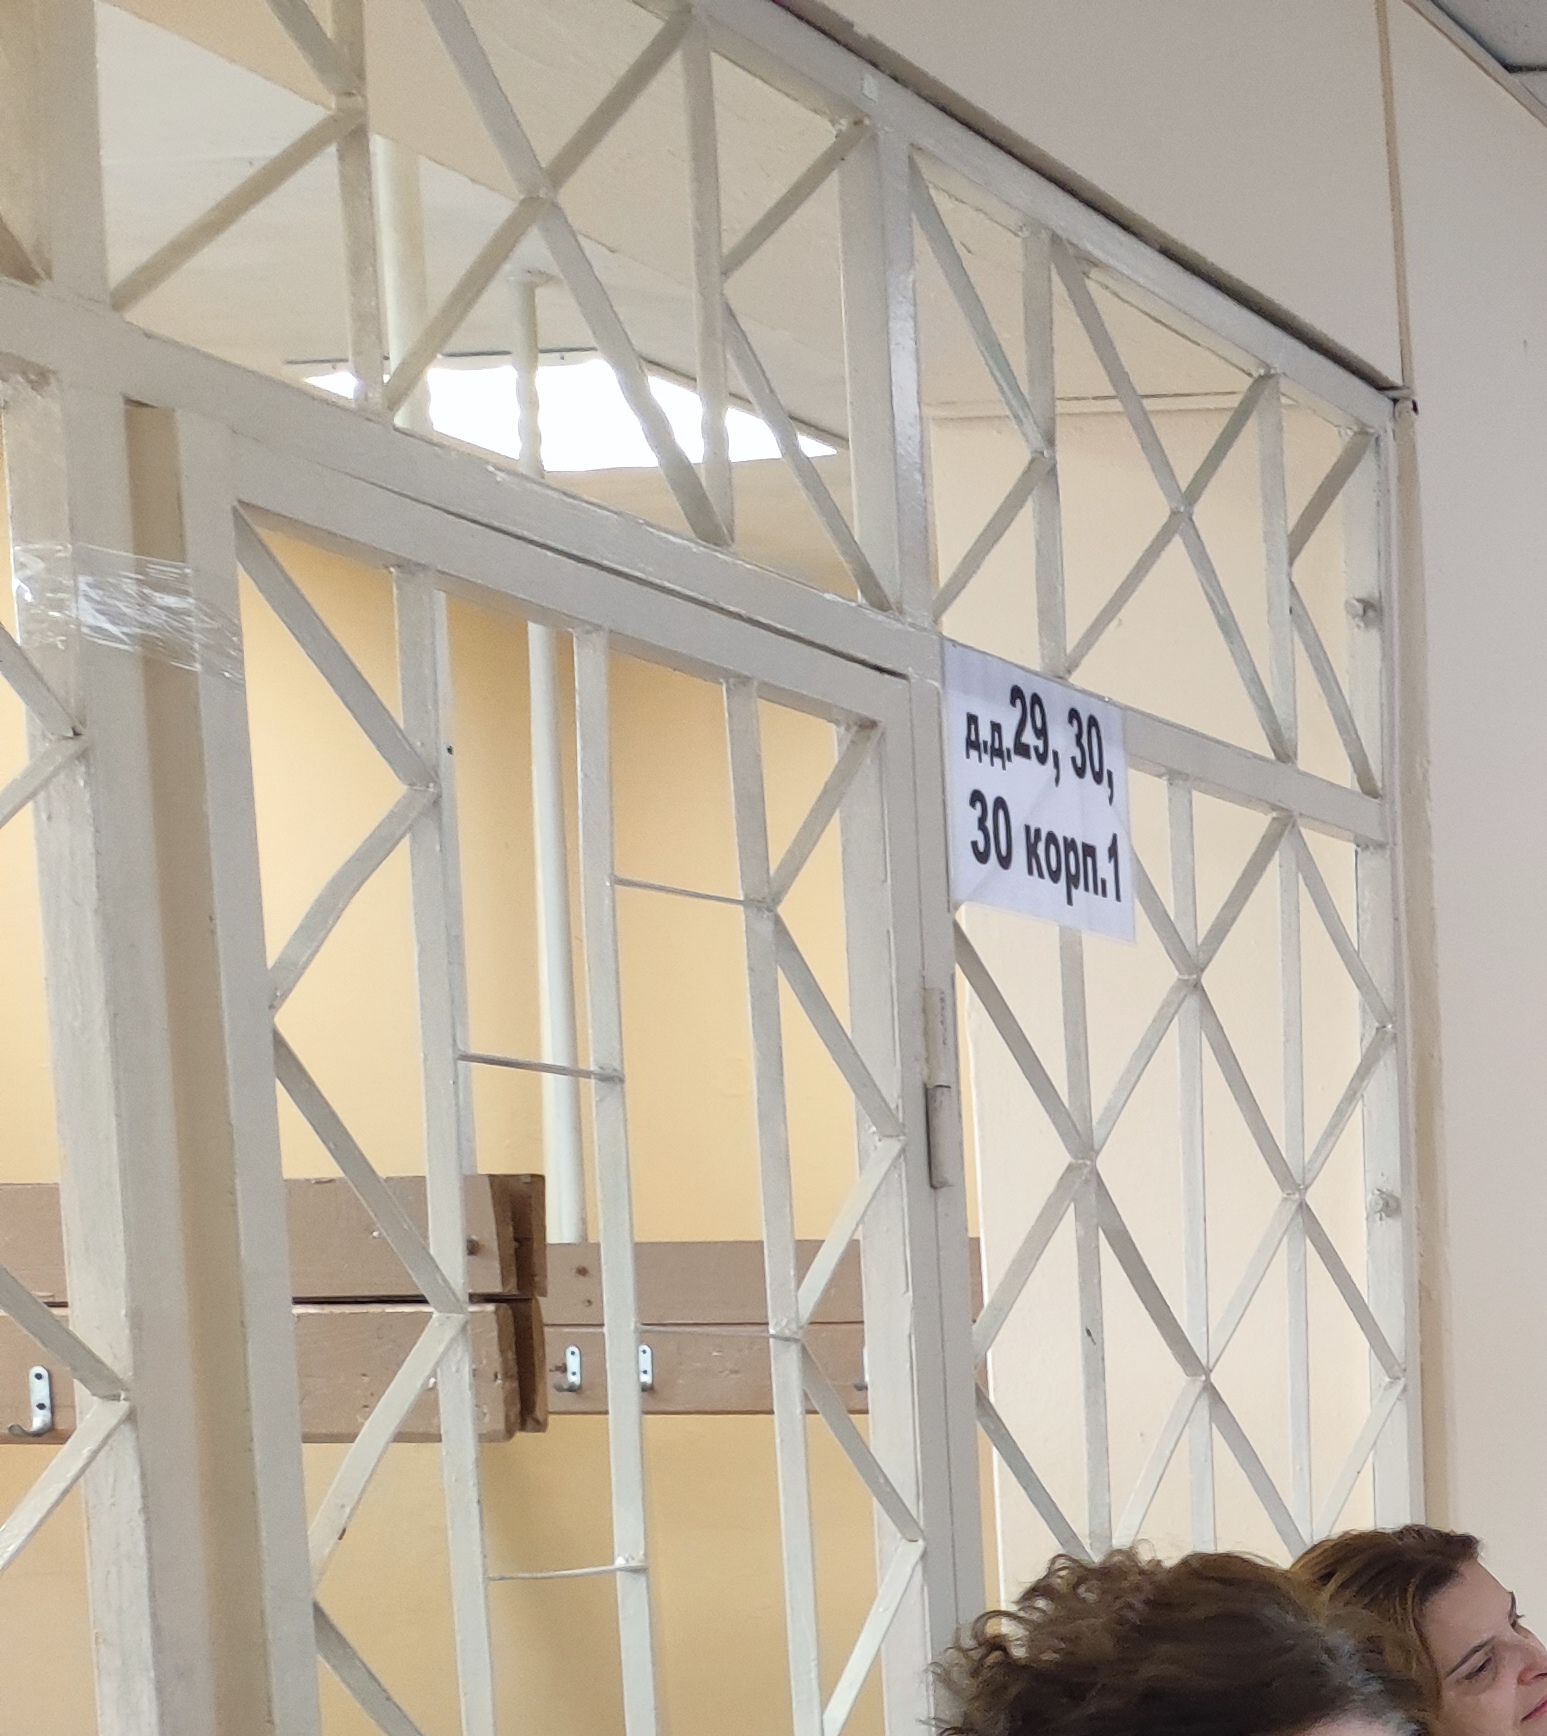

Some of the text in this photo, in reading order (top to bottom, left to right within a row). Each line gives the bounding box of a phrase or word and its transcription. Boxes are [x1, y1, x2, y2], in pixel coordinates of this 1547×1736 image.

[966, 685, 1115, 806] д.д.29, 30,
[969, 789, 1121, 906] 30 корп.1
